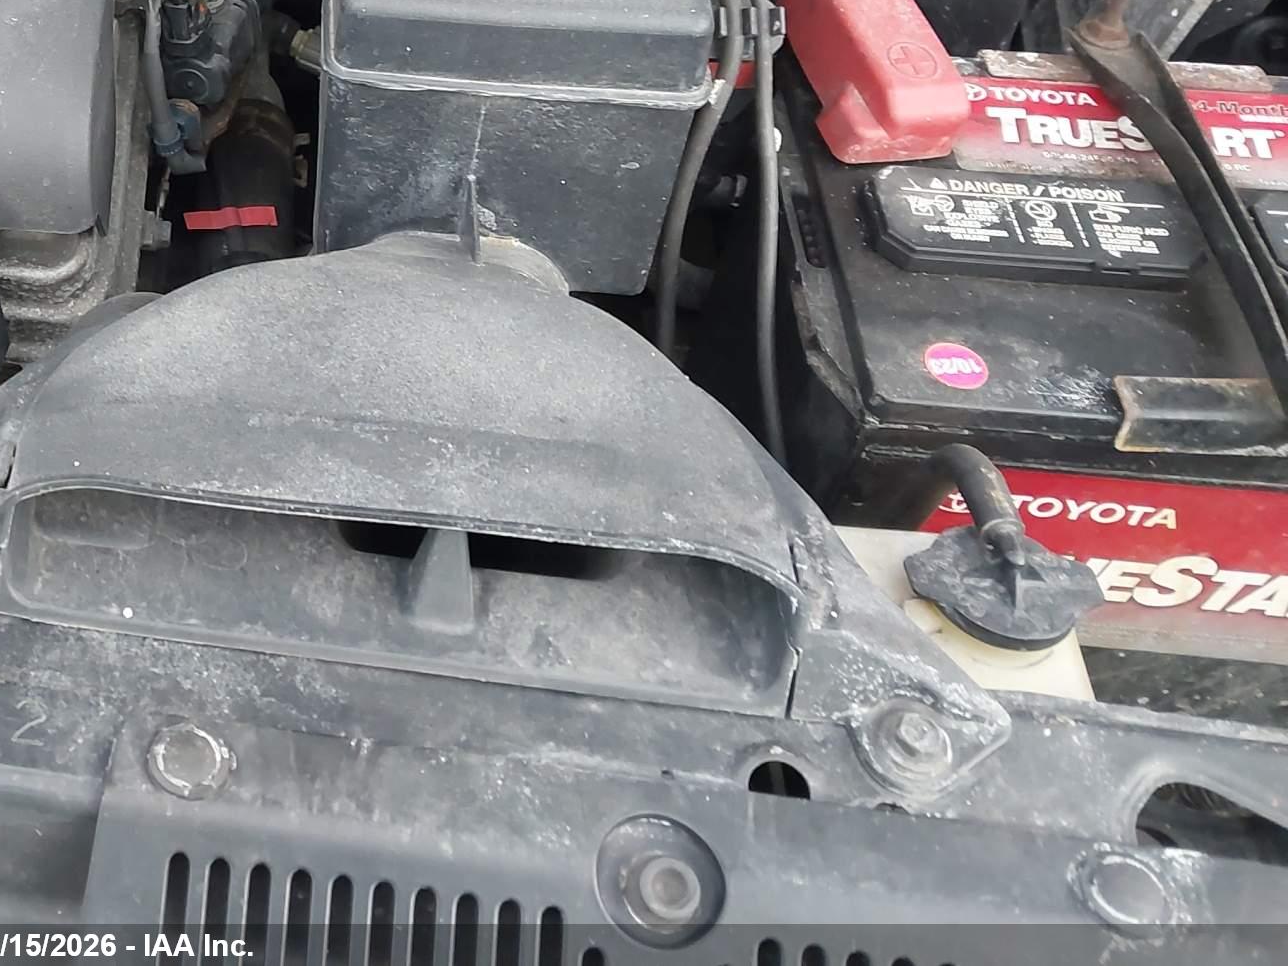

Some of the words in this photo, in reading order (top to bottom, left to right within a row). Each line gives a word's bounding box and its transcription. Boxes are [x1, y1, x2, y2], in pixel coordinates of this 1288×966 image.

[987, 87, 1098, 107] TOYOTA
[949, 179, 1030, 195] DANGER
[1048, 186, 1124, 203] POISON
[1013, 493, 1177, 530] TOYOTA
